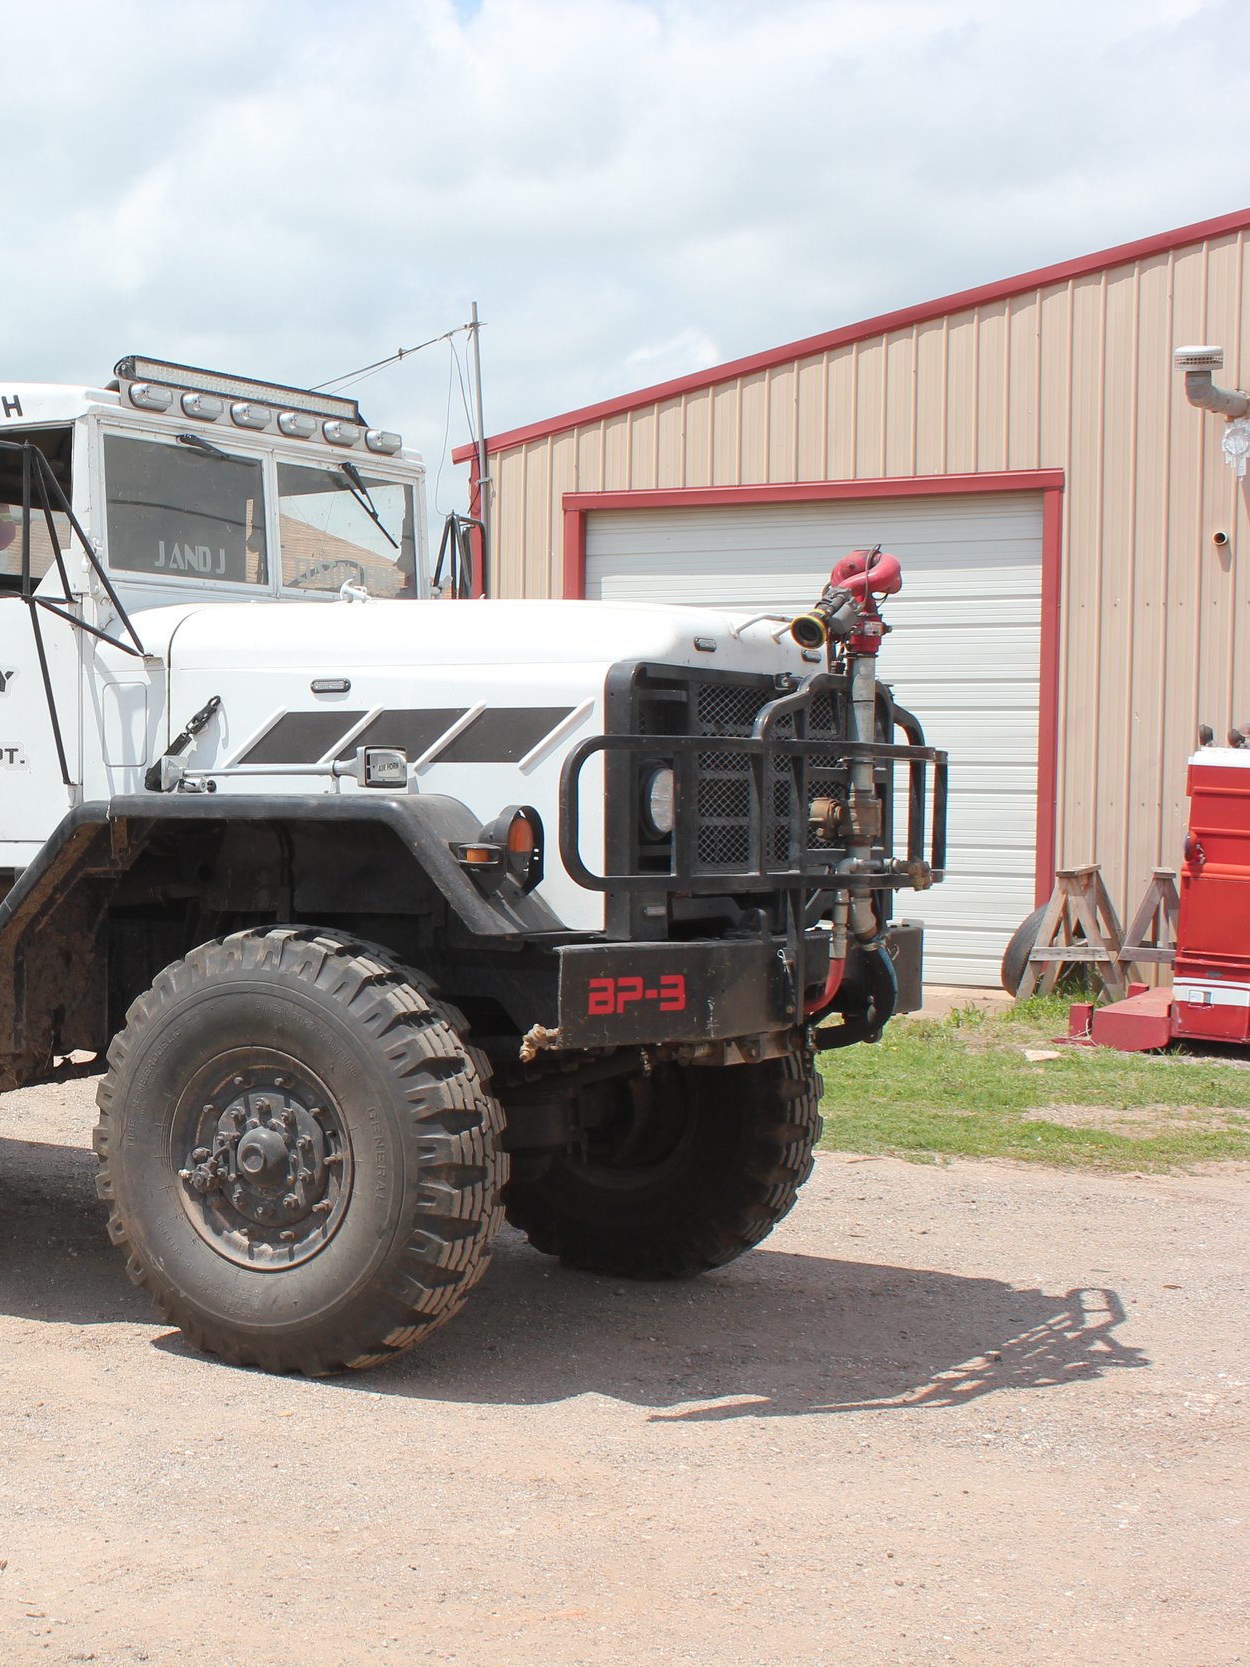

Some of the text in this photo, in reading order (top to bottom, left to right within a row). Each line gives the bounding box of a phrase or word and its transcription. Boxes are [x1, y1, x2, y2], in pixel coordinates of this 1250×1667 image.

[154, 540, 226, 575] J AND J
[588, 974, 686, 1015] BP-3
[368, 1106, 386, 1205] GENERAL
